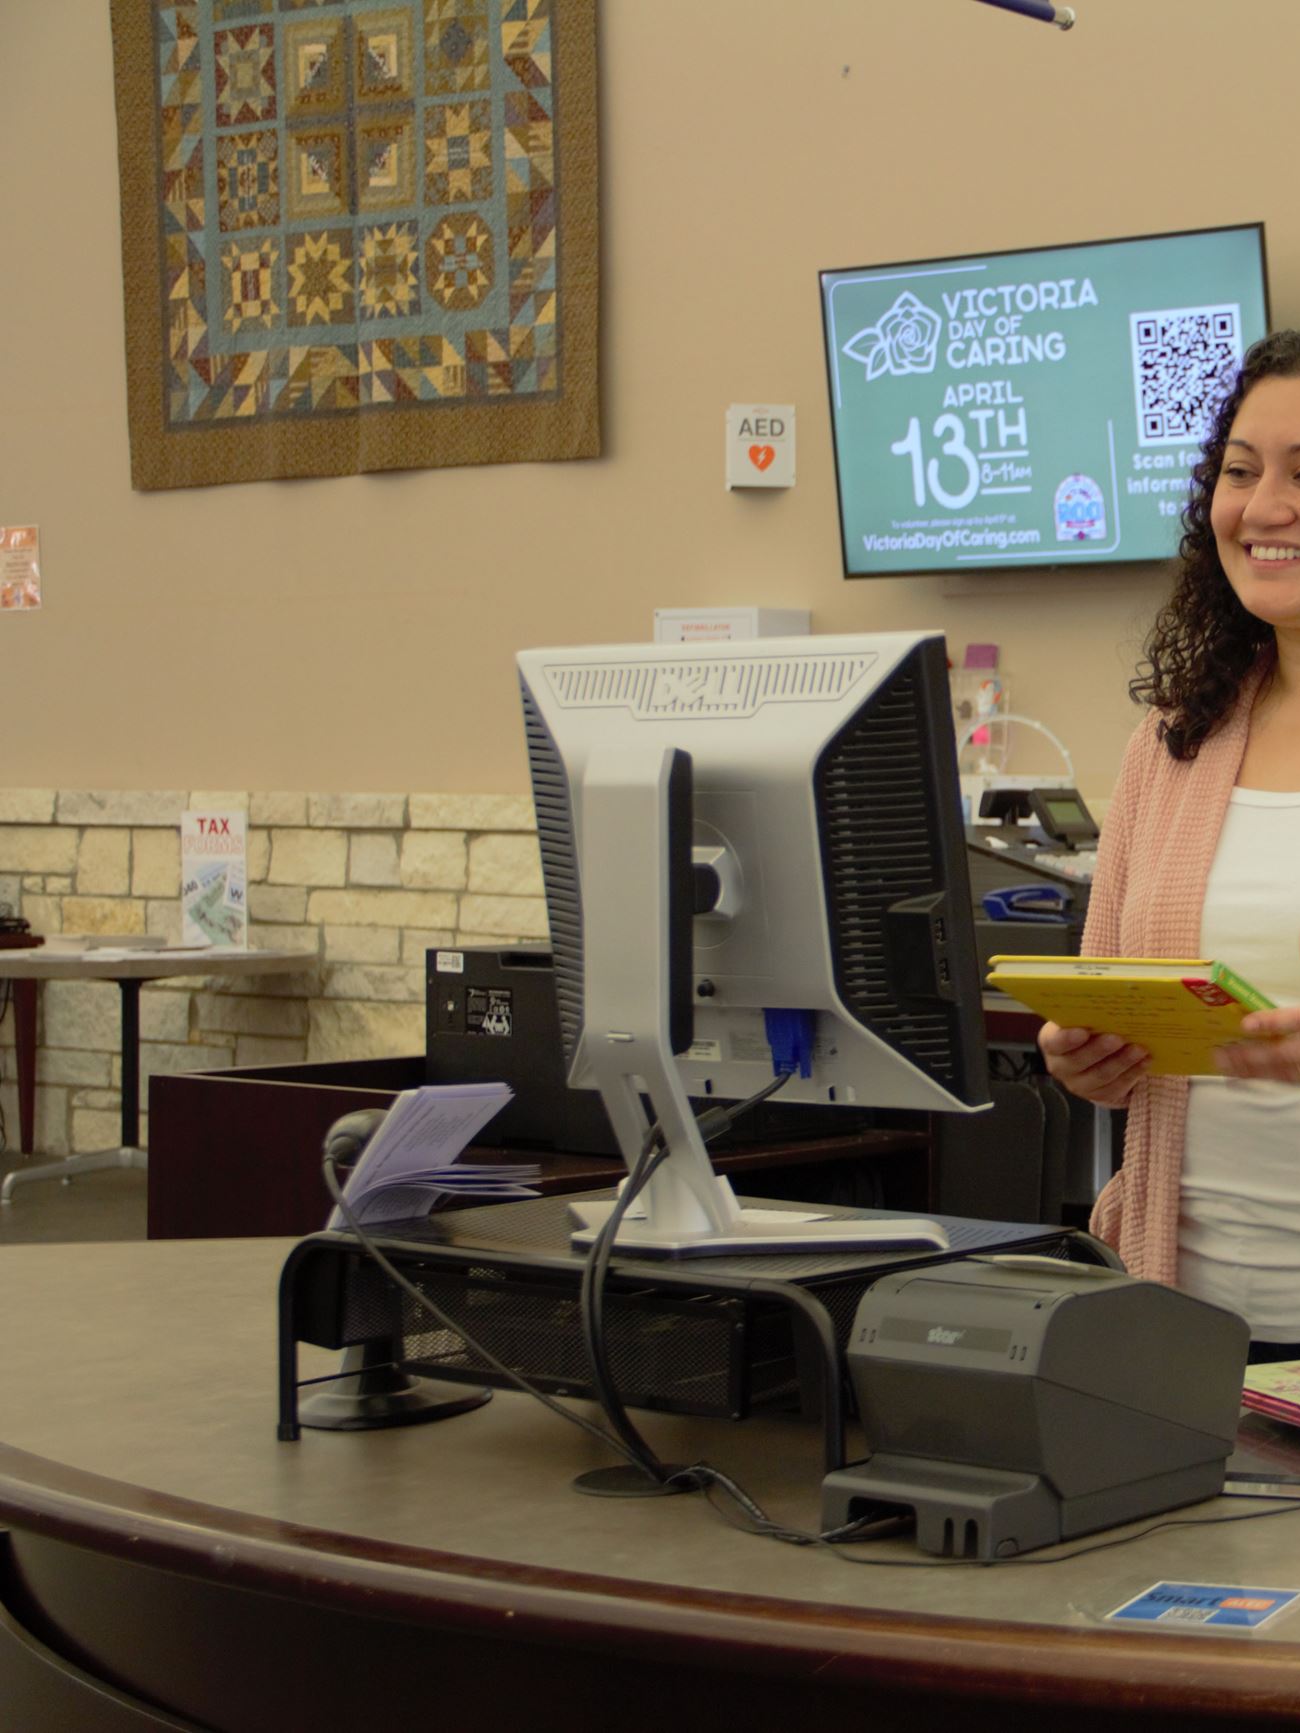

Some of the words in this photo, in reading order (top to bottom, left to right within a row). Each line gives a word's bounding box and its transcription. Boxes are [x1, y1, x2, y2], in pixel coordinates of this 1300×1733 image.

[942, 278, 1098, 319] VICTORIA
[949, 319, 987, 340] DAY
[994, 314, 1023, 335] OF
[946, 332, 1067, 369] CARING
[943, 380, 1024, 408] APRIL
[738, 417, 785, 437] AED
[1132, 453, 1175, 471] Scan
[863, 528, 1041, 552] VictoriaDayOfCaring.com
[197, 817, 231, 836] TAX
